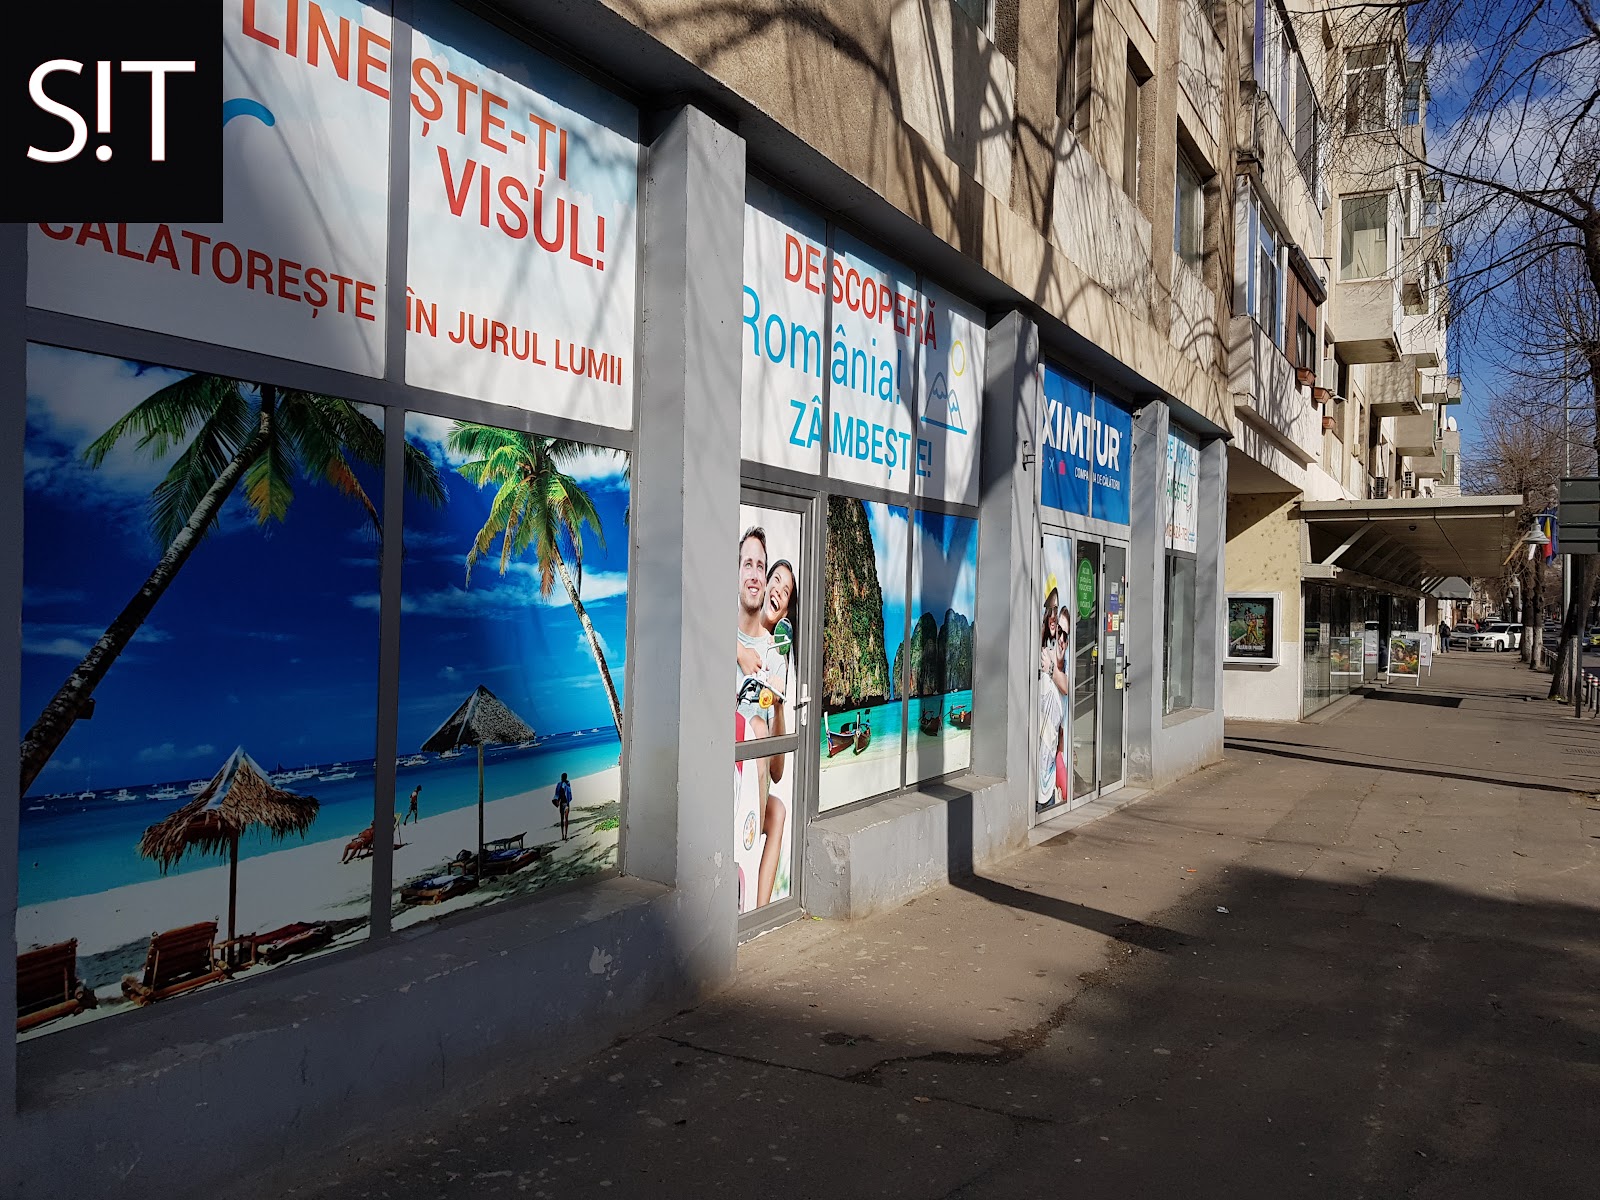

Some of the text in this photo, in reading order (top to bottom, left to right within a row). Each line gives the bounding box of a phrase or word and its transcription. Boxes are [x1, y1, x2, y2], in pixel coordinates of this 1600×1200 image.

[437, 145, 605, 271] VISUL!
[405, 286, 437, 338] ÎN
[448, 311, 547, 367] JURUL
[555, 339, 622, 386] LUMII
